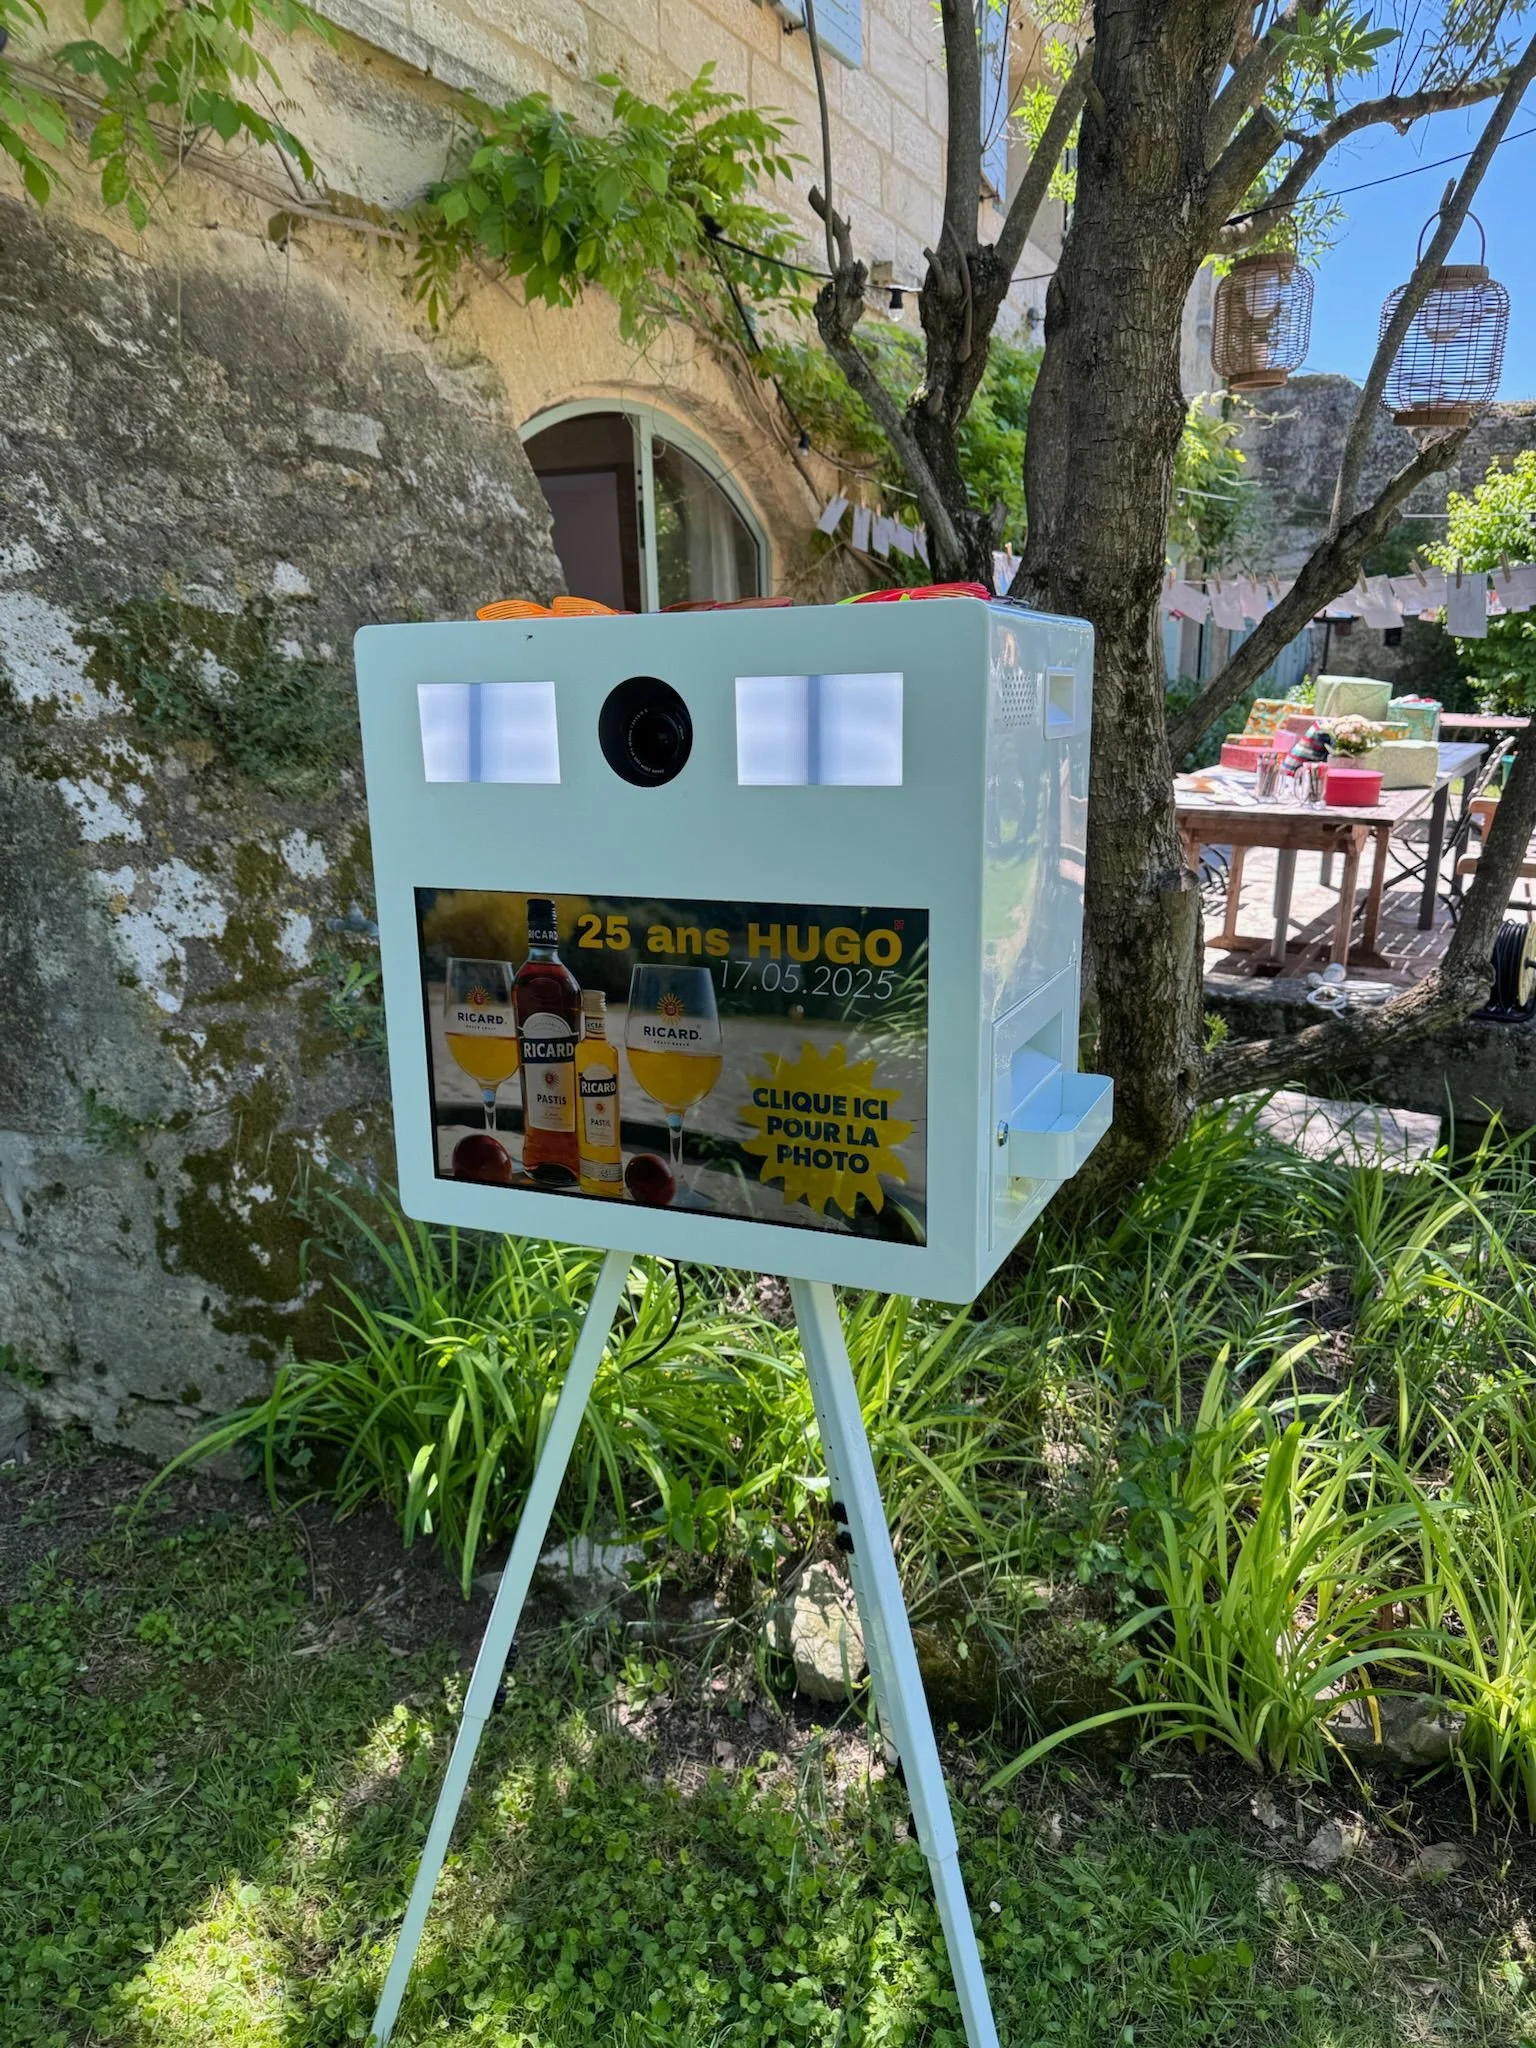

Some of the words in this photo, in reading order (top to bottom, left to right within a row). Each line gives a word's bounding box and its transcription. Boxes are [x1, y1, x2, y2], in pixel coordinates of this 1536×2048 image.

[577, 914, 631, 950] 25
[647, 924, 730, 957] ans
[748, 923, 902, 967] HUGO
[720, 959, 895, 1000] 17.05.2025
[523, 1042, 574, 1058] RICARD
[537, 1094, 567, 1105] PASTIS
[581, 1081, 617, 1094] RICARD
[752, 1087, 847, 1114] CLIQUE
[854, 1097, 888, 1120] ICI
[767, 1115, 840, 1143] POUR
[847, 1124, 880, 1148] LA
[777, 1144, 870, 1174] PHOTO
